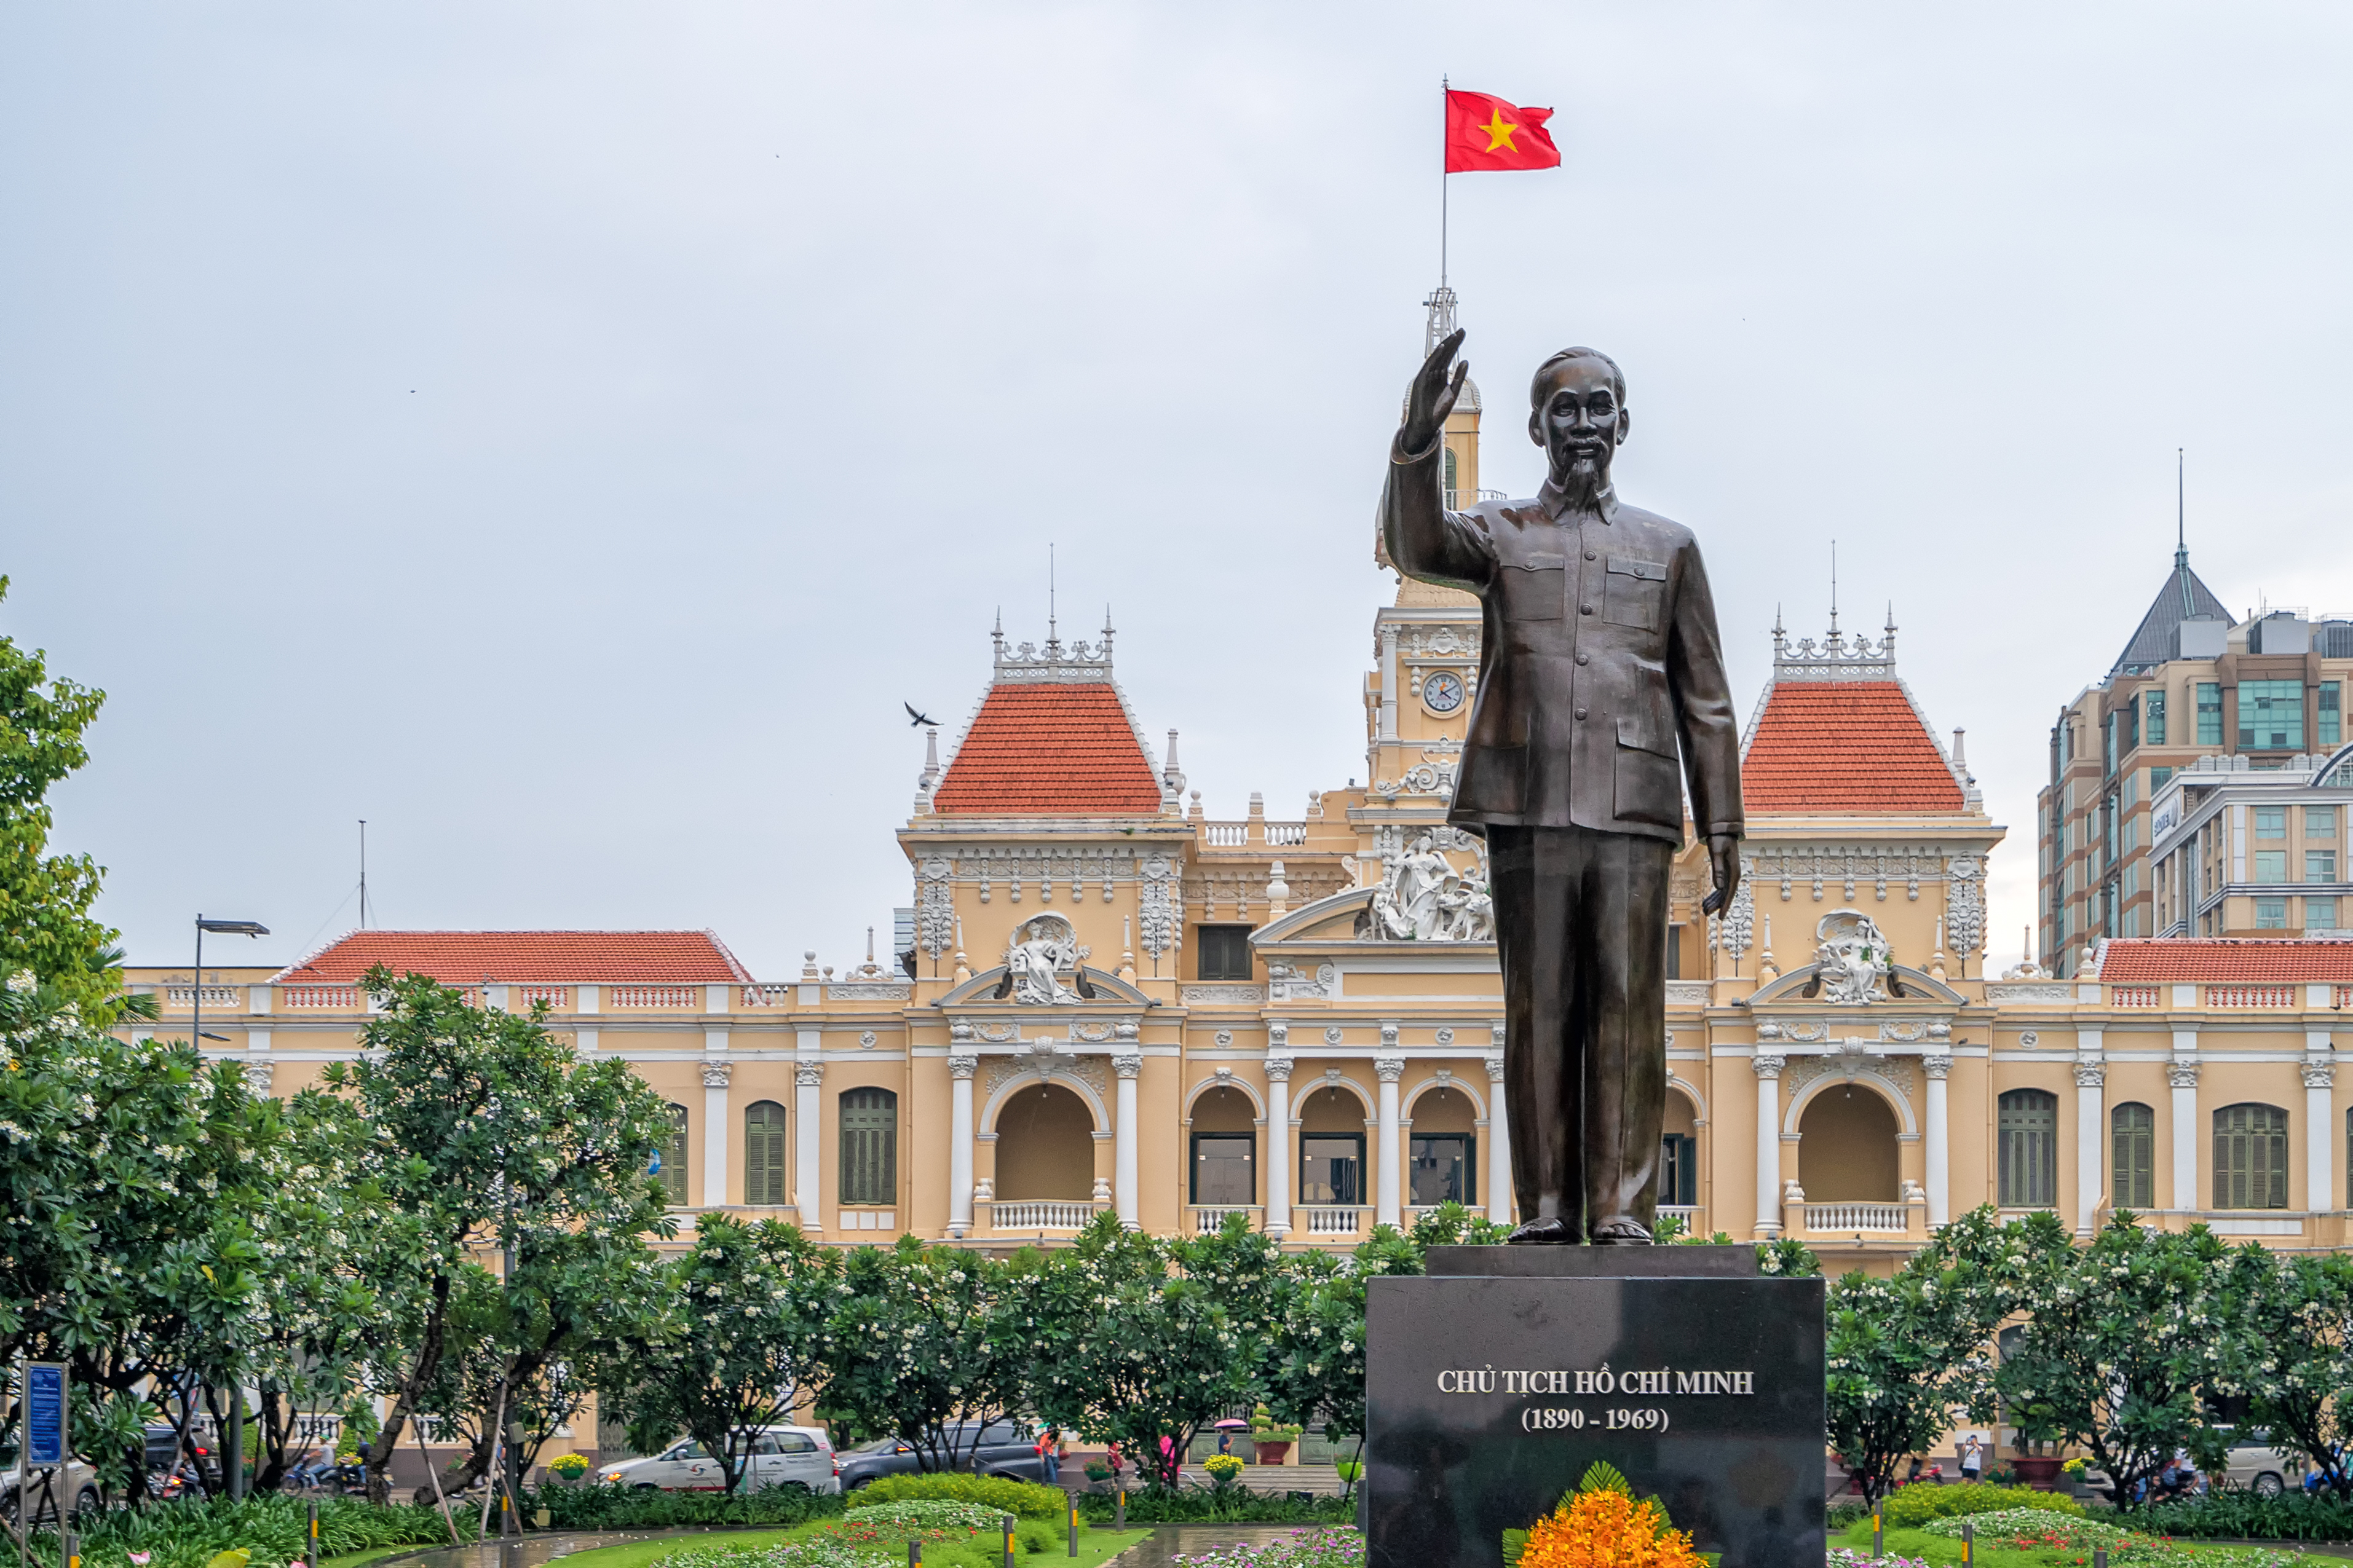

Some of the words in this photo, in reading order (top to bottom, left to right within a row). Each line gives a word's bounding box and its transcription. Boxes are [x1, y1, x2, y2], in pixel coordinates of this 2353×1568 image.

[1438, 1364, 1497, 1393] CHỦ
[1502, 1371, 1568, 1397] TỊCH
[1574, 1362, 1615, 1393] HỒ
[1619, 1366, 1671, 1394] CHÍ
[1675, 1371, 1754, 1394] MINH
[1522, 1408, 1584, 1432] (1890
[1605, 1408, 1669, 1433] 1969)
